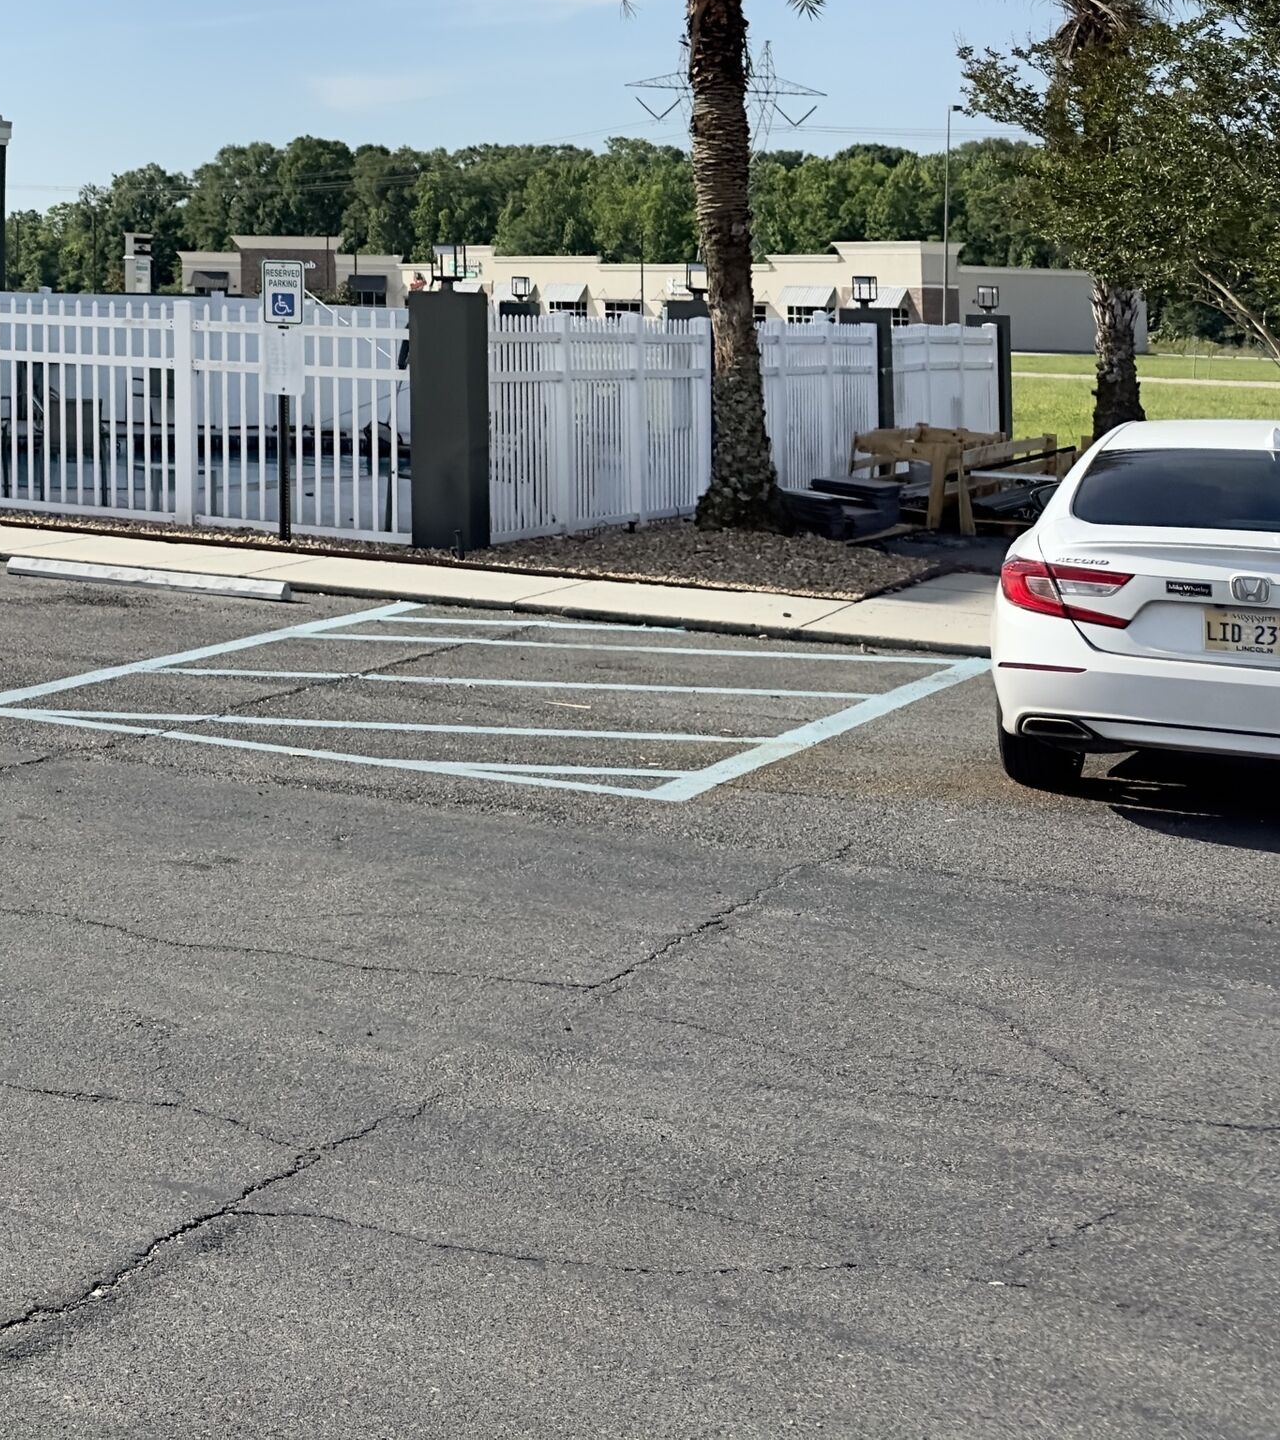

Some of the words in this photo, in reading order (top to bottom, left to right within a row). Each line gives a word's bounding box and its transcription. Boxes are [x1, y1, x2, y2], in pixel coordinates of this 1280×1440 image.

[265, 268, 300, 278] RESERVED
[268, 279, 298, 289] PARKING
[1054, 556, 1110, 566] ACCORD
[1168, 583, 1183, 591] Mike
[1206, 621, 1242, 643] LID
[1254, 625, 1280, 645] 23
[1235, 645, 1274, 654] LINCOLN
